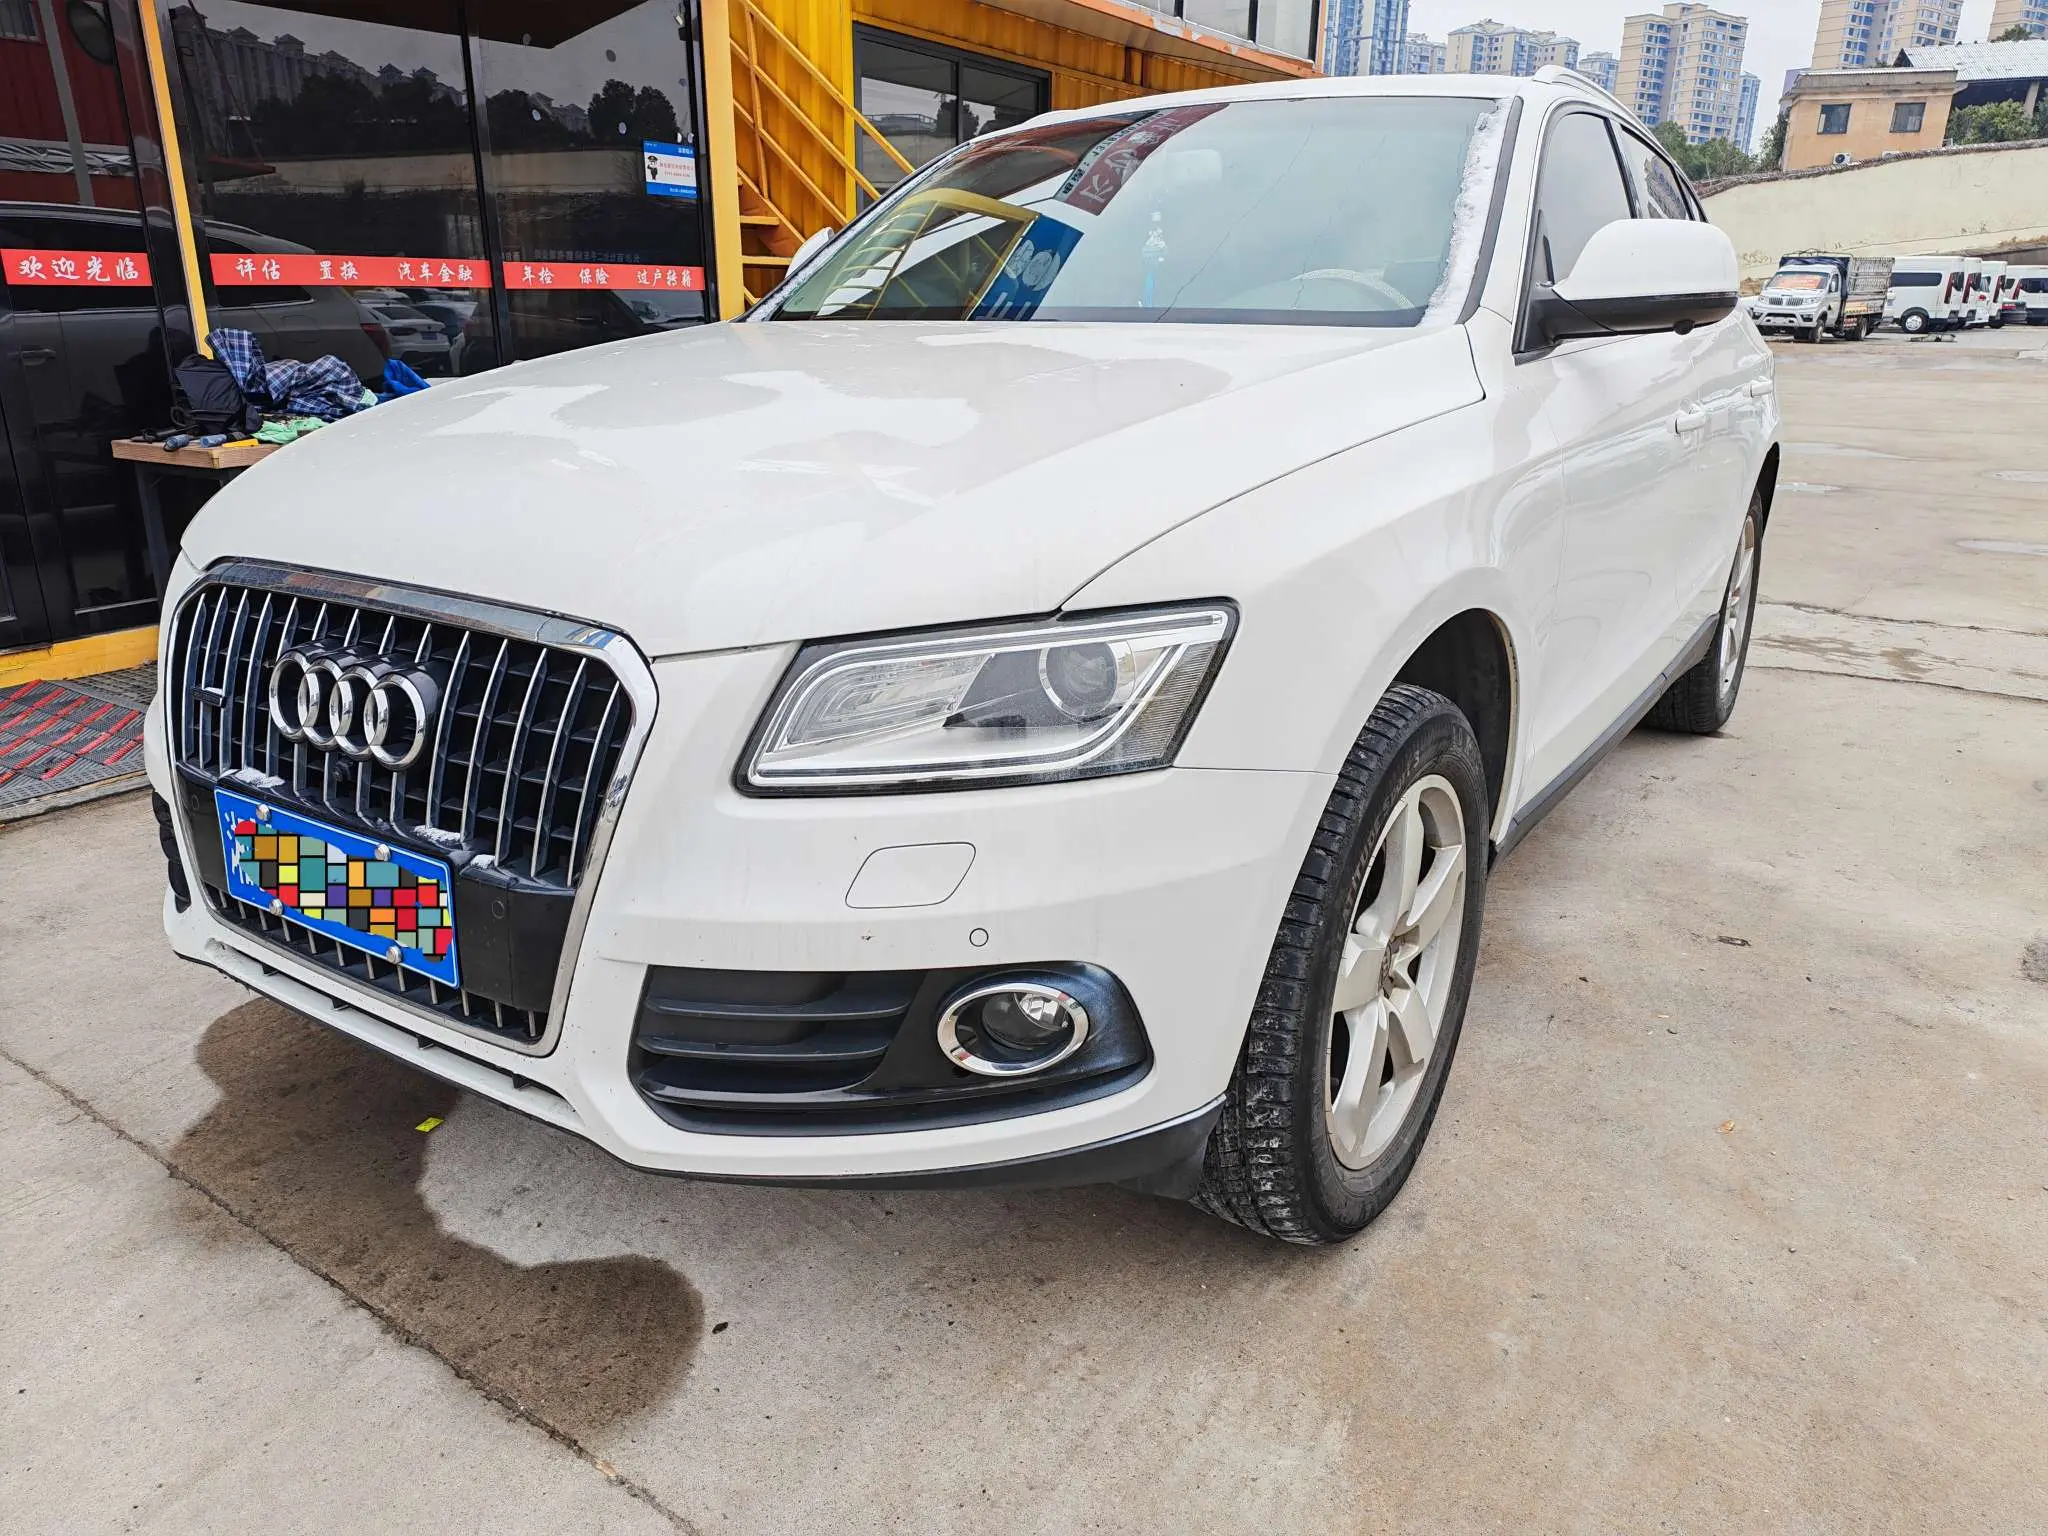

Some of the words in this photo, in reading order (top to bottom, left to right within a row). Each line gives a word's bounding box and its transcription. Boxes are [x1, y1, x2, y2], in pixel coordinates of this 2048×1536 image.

[19, 256, 139, 282] 欢迎光临
[234, 257, 281, 282] 评估
[318, 258, 360, 281] 置换
[397, 262, 474, 283] 汽车金融
[521, 265, 555, 287] 年检
[578, 266, 610, 287] 保险
[636, 269, 693, 288] 过户转籍
